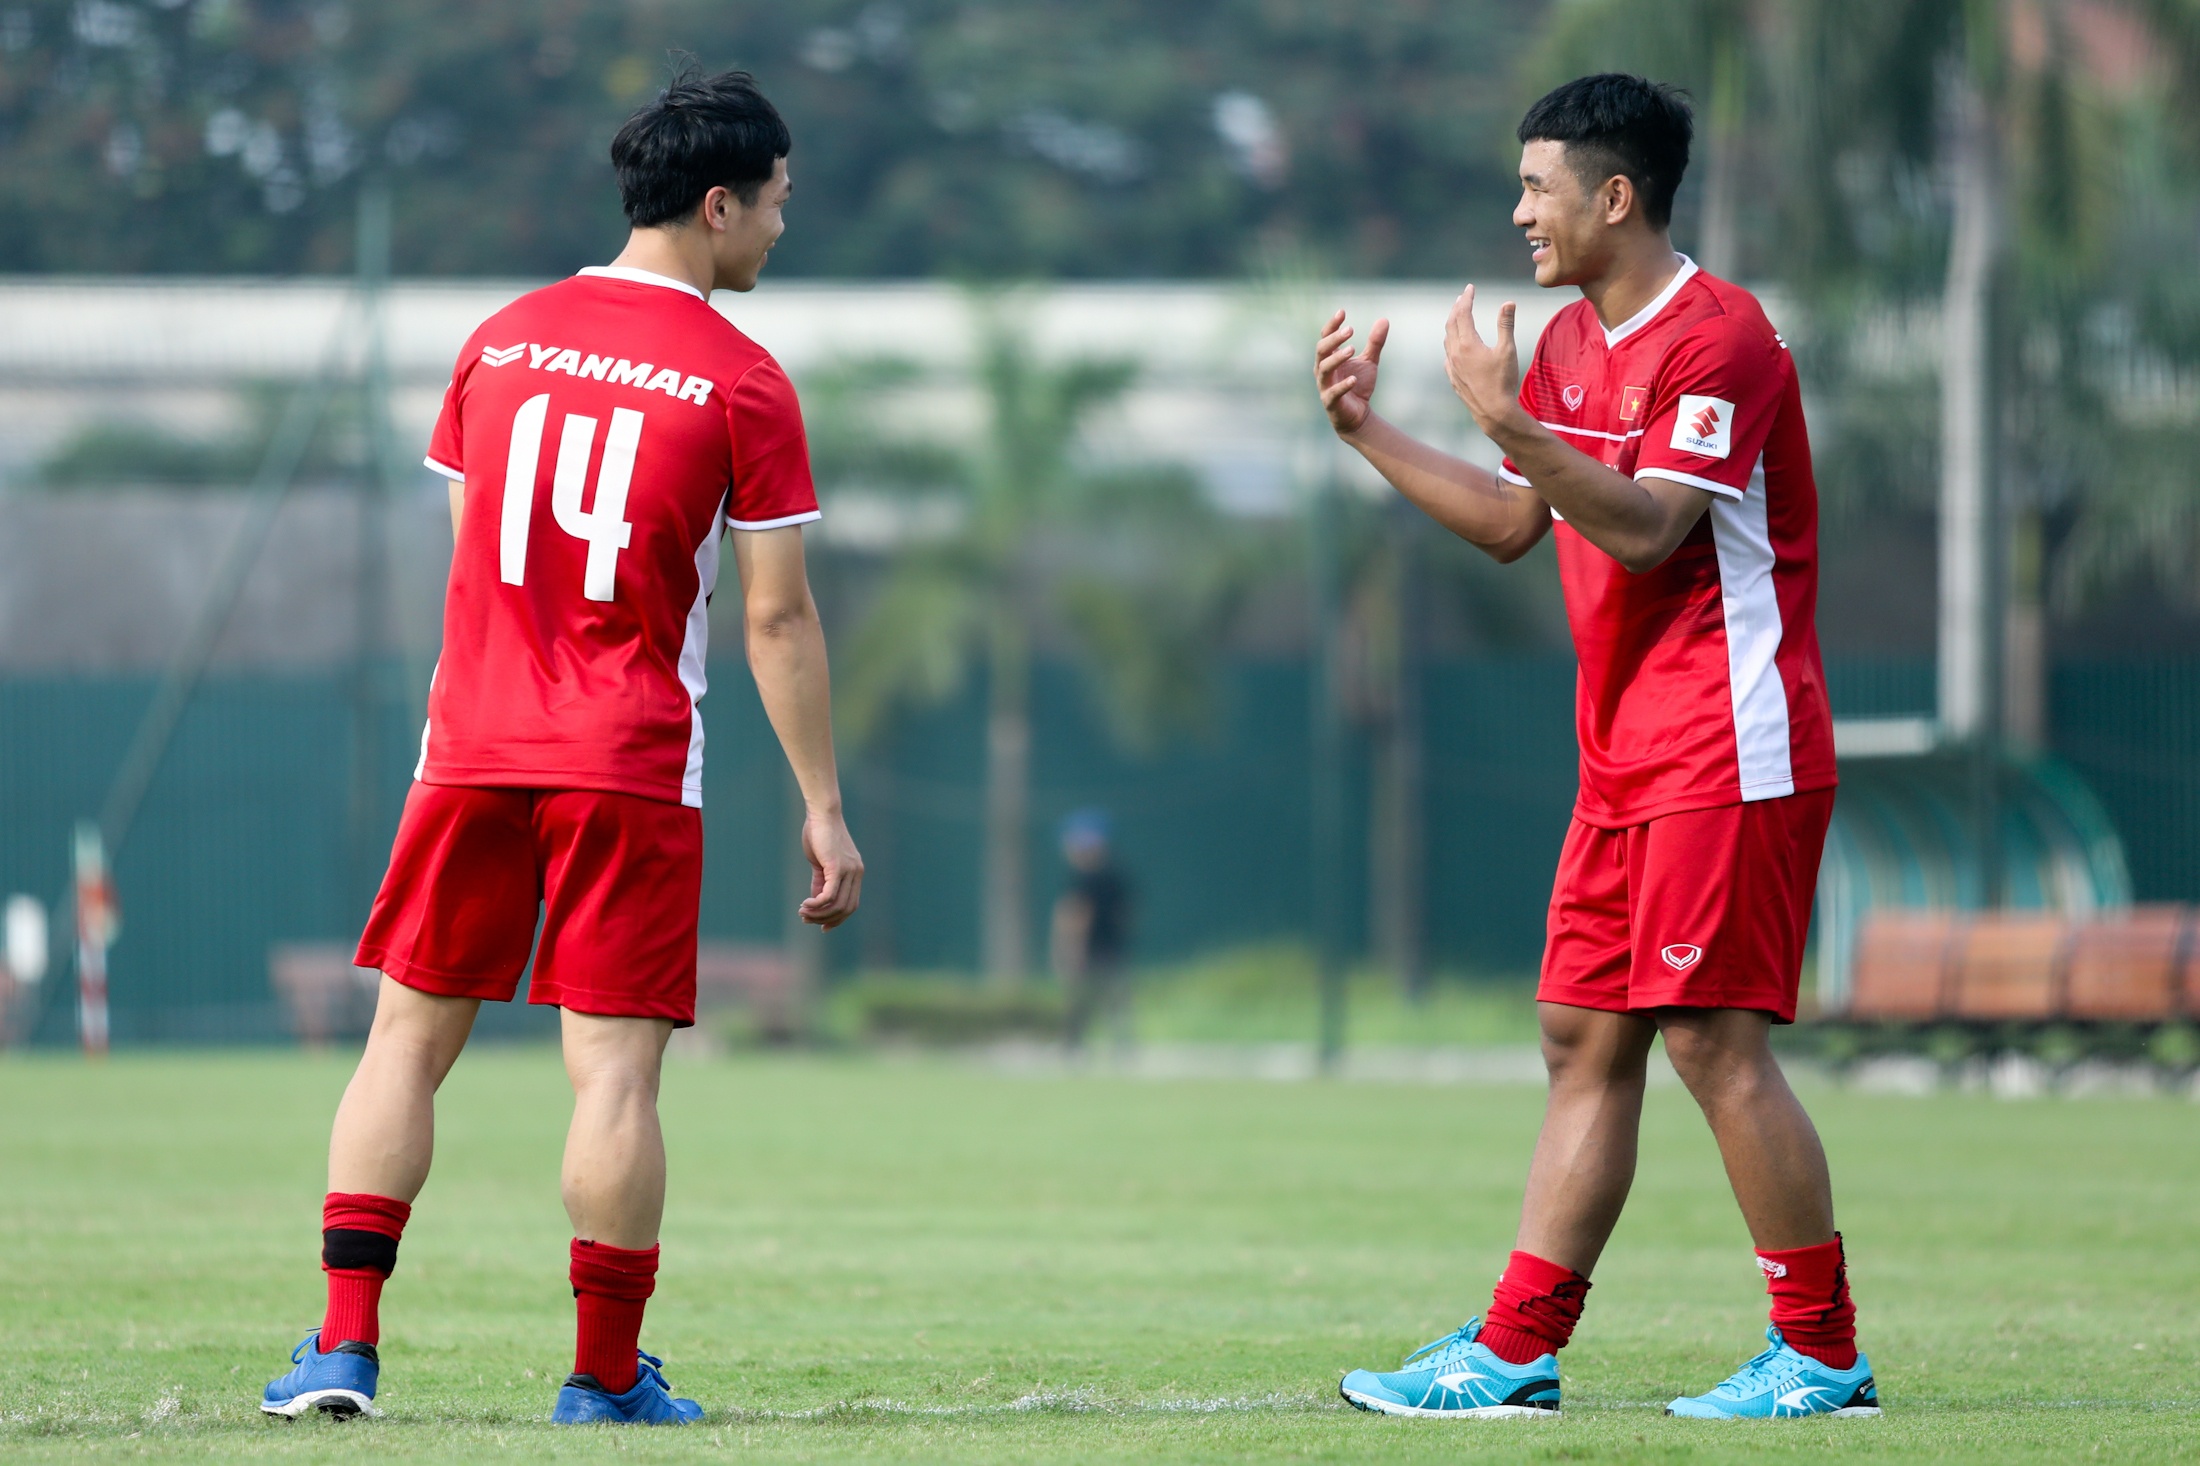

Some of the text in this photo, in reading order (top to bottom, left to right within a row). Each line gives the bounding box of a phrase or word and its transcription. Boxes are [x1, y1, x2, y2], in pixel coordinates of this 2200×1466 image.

[529, 343, 714, 406] YANMAR
[1686, 437, 1718, 450] SUZUKI
[500, 393, 645, 602] 14
